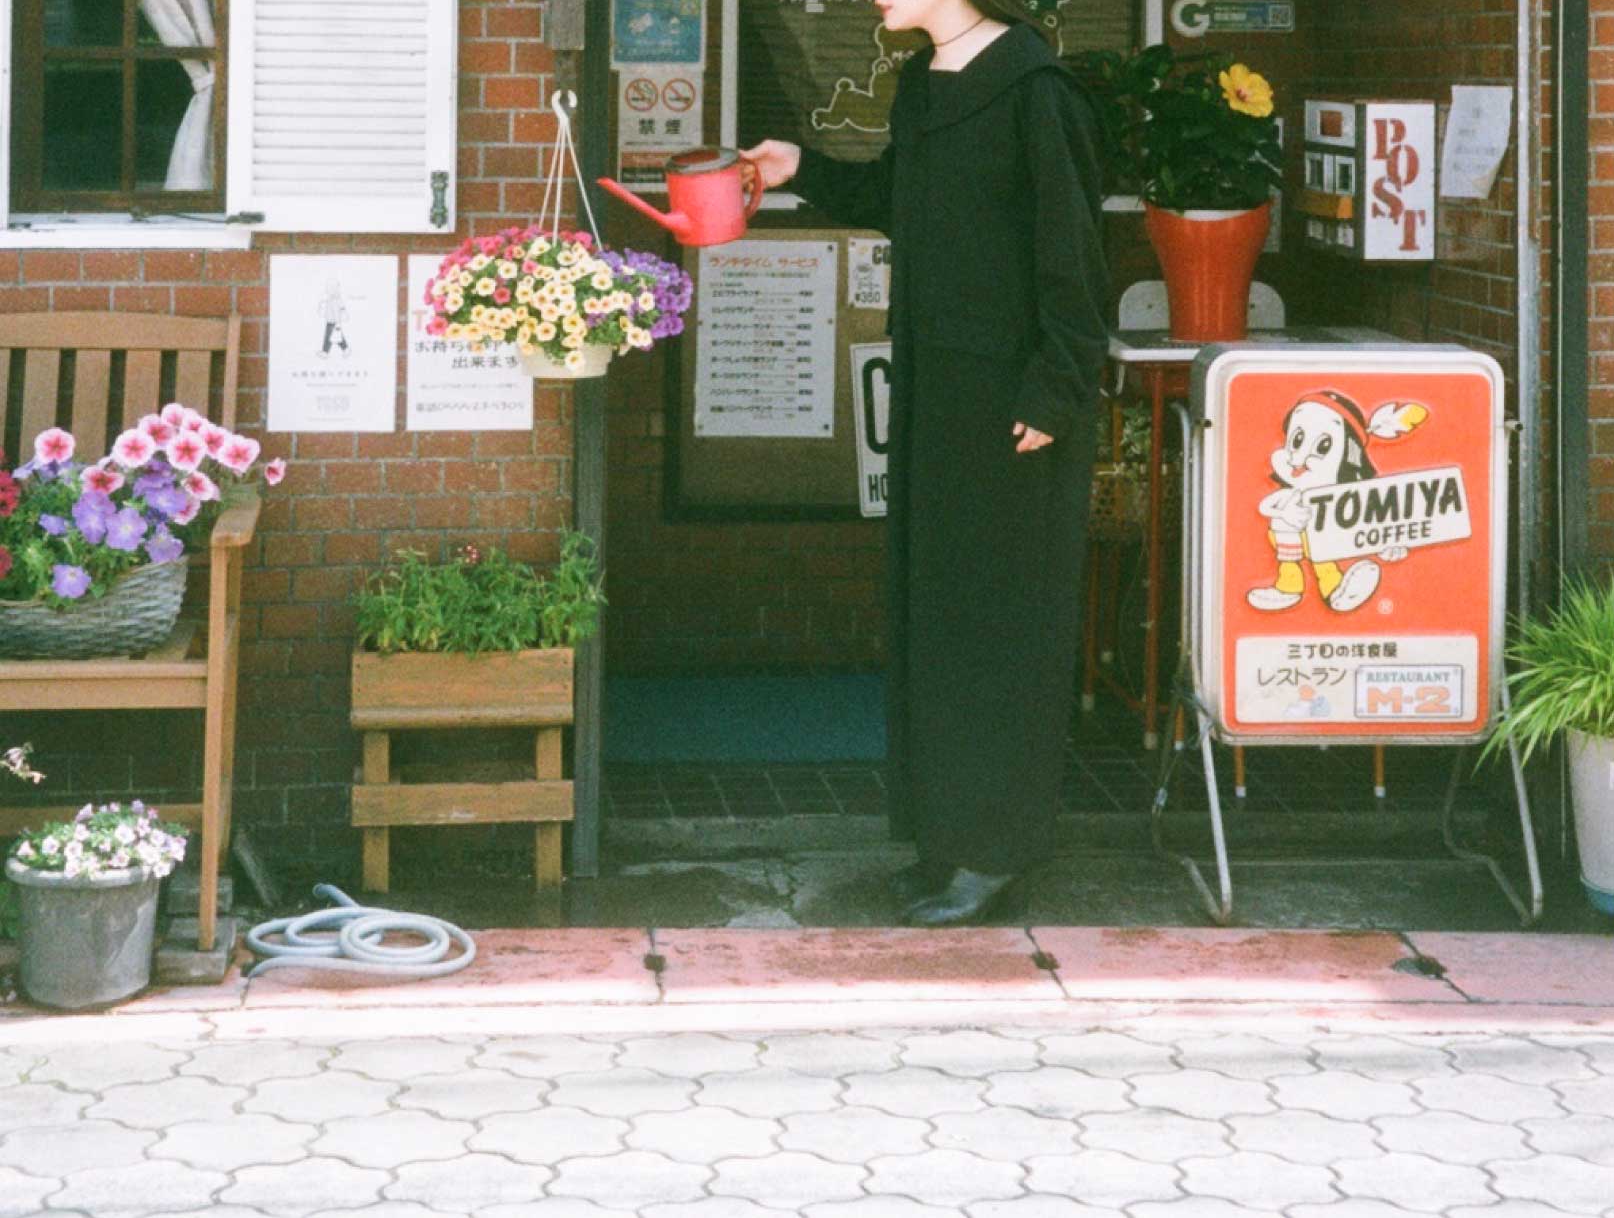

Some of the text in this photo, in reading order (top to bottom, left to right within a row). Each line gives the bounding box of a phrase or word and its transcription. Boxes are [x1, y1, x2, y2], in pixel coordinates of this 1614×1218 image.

[638, 118, 682, 135] 禁煙
[1371, 117, 1426, 252] POST
[1308, 476, 1463, 532] TOMIYA
[1353, 520, 1433, 549] COFFEE
[1256, 666, 1348, 688] レストラン
[1365, 671, 1451, 683] RESTAURANT
[1366, 686, 1451, 715] M-2
